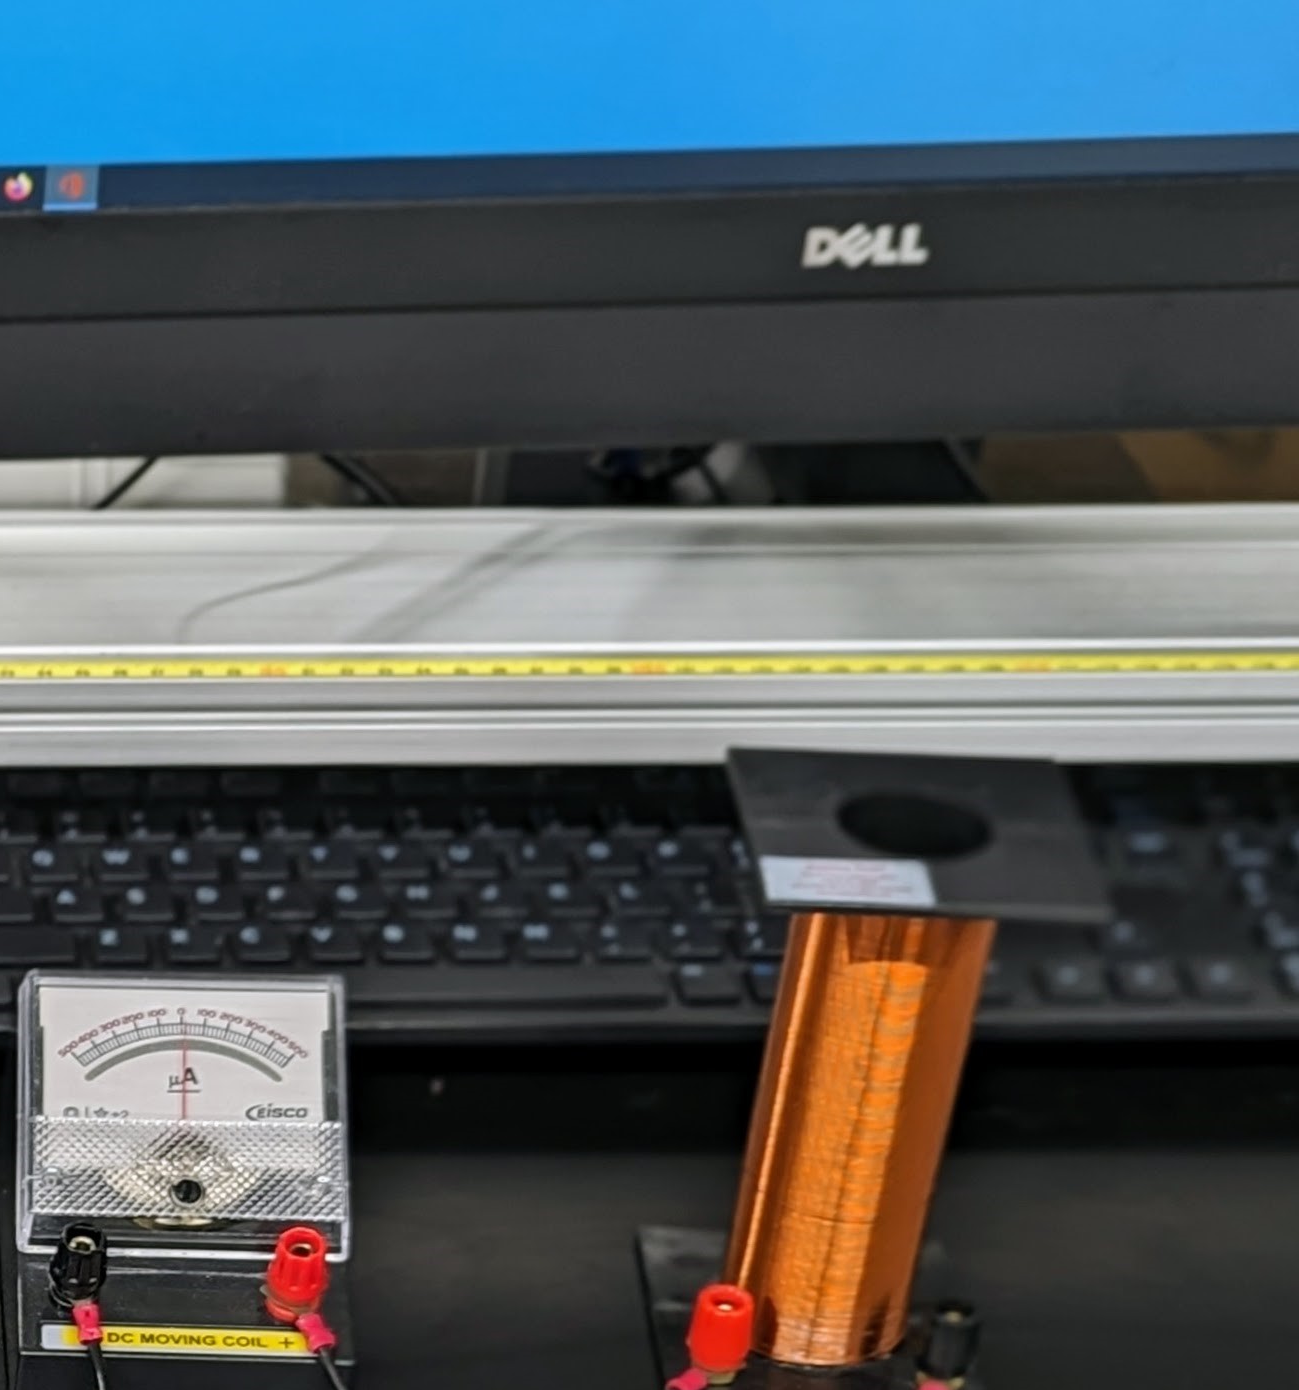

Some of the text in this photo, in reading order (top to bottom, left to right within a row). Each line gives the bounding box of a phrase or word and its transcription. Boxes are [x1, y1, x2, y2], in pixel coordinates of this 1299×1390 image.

[801, 222, 929, 269] DELL
[57, 1040, 79, 1057] 500
[122, 1012, 144, 1025] 200
[147, 1008, 167, 1018] 100
[177, 1007, 185, 1016] 0
[198, 1008, 216, 1019] 100
[219, 1012, 243, 1024] 200
[245, 1018, 267, 1034] 300
[267, 1029, 290, 1044] 400
[288, 1041, 308, 1059] 500
[107, 1332, 134, 1345] DC
[140, 1332, 217, 1348] MOVING
[222, 1336, 268, 1349] COIL
